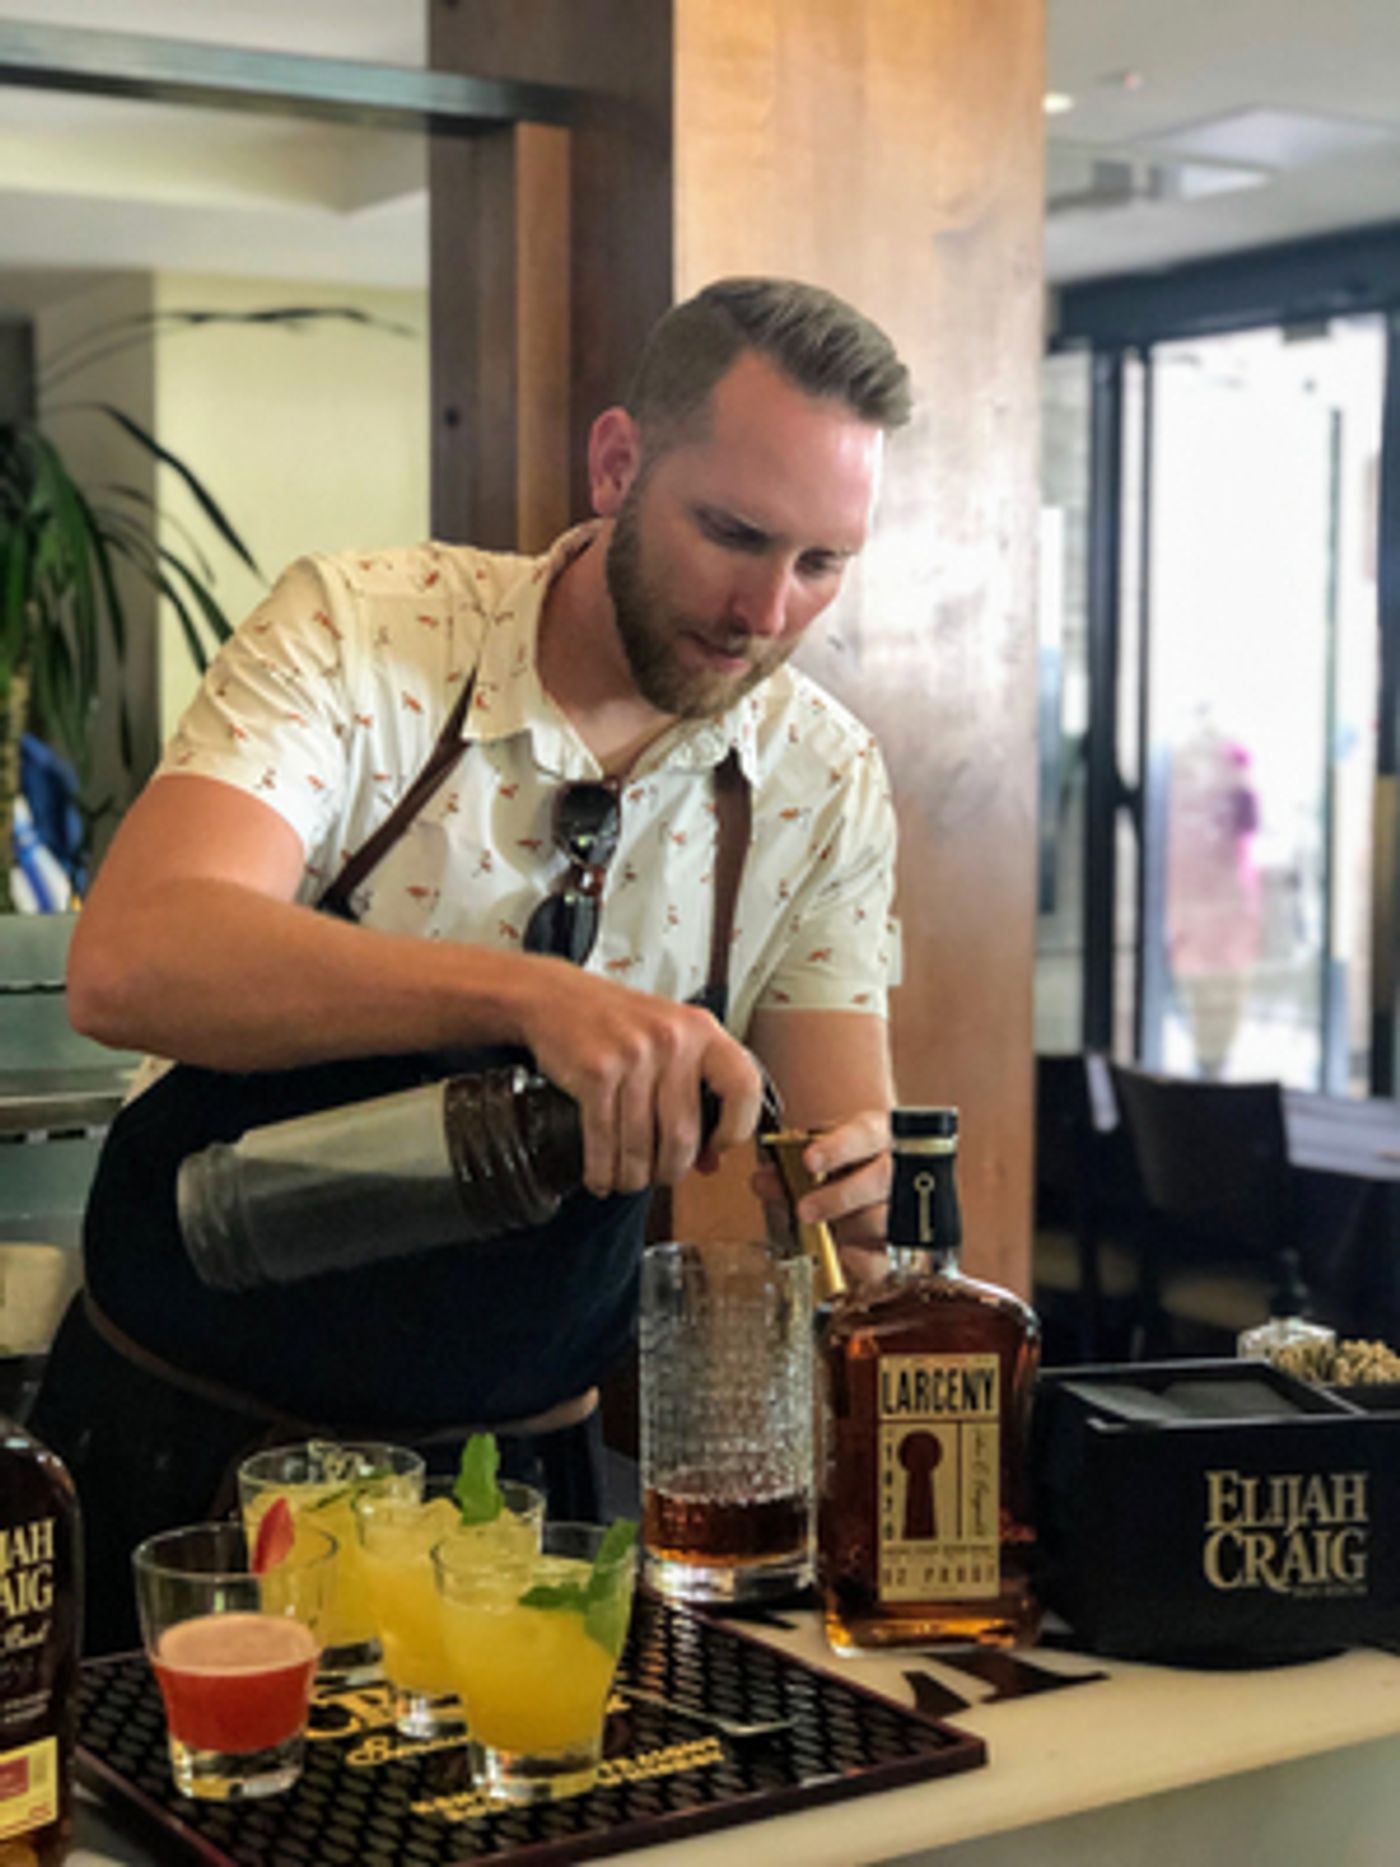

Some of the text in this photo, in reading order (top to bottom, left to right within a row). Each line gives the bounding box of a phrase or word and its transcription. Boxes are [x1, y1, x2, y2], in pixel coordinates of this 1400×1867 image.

[882, 1368, 996, 1414] LARCENY
[1204, 1470, 1370, 1532] ELIJAH
[1203, 1528, 1369, 1594] CRAIG
